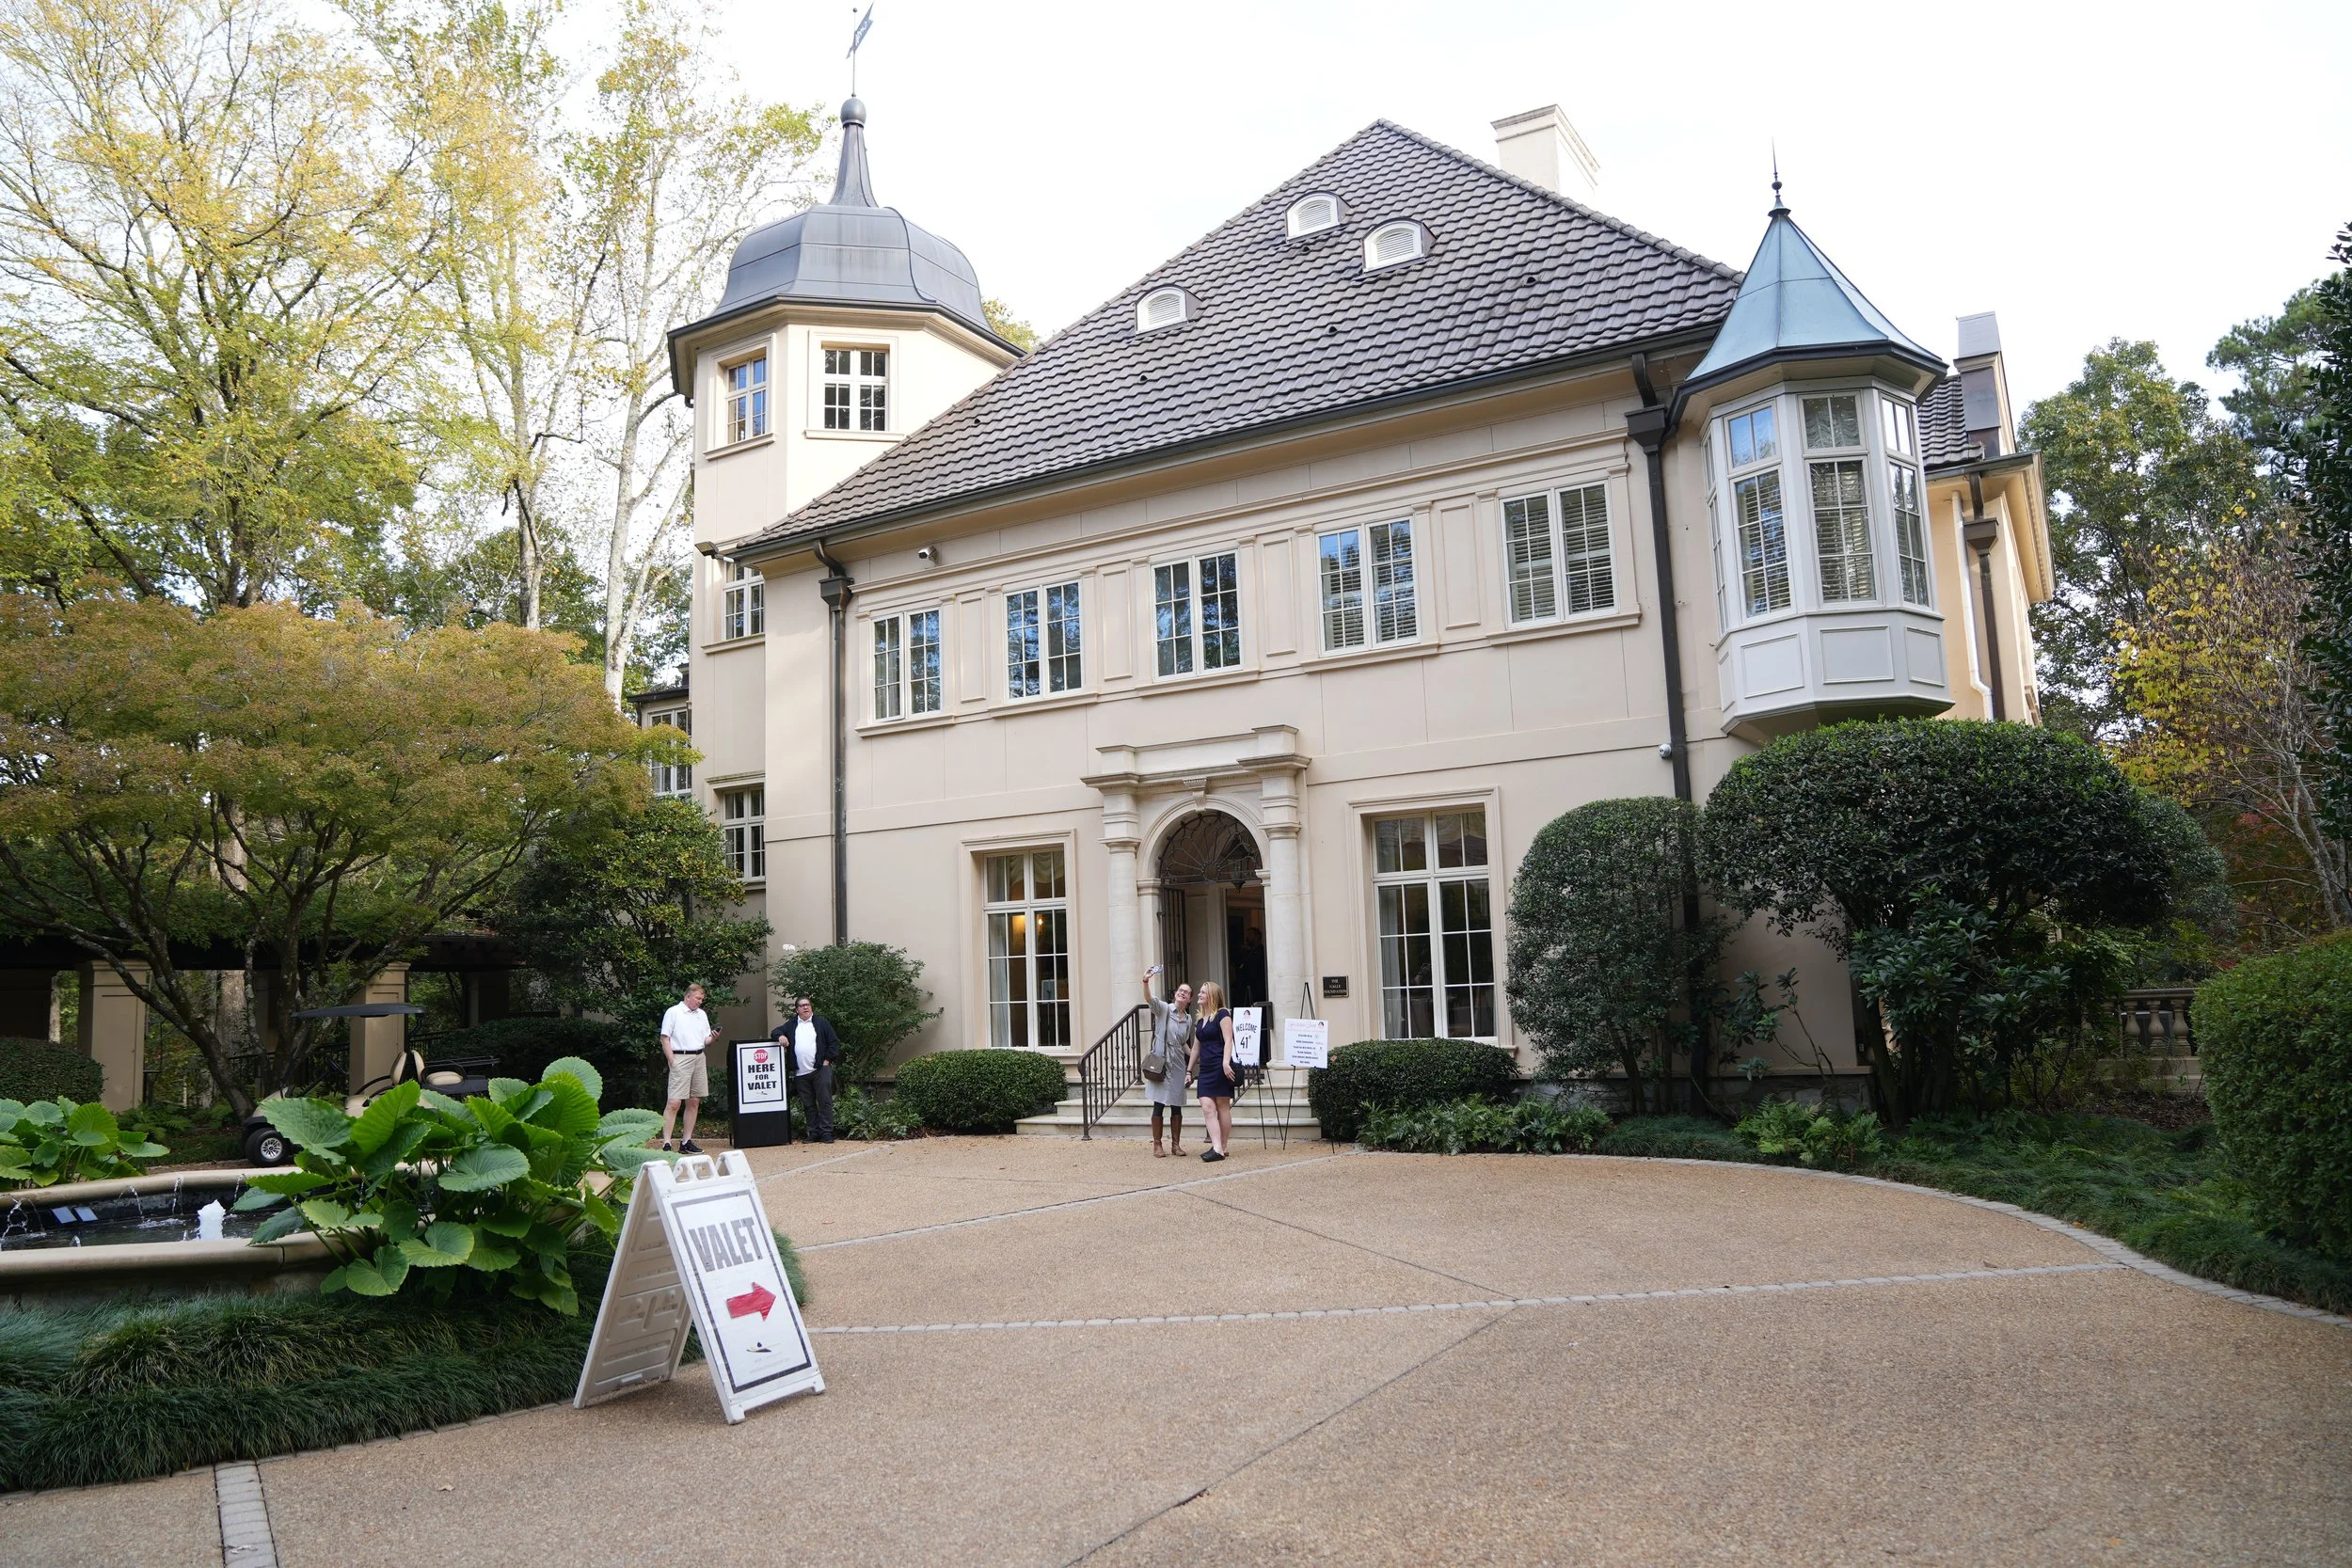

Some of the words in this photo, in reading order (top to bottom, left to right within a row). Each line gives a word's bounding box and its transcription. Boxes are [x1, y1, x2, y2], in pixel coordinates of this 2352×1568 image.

[1235, 1022, 1258, 1034] WELCOME
[754, 1052, 768, 1060] STOP
[747, 1063, 775, 1073] HERE
[747, 1080, 777, 1091] VALET
[689, 1216, 763, 1273] VALET
